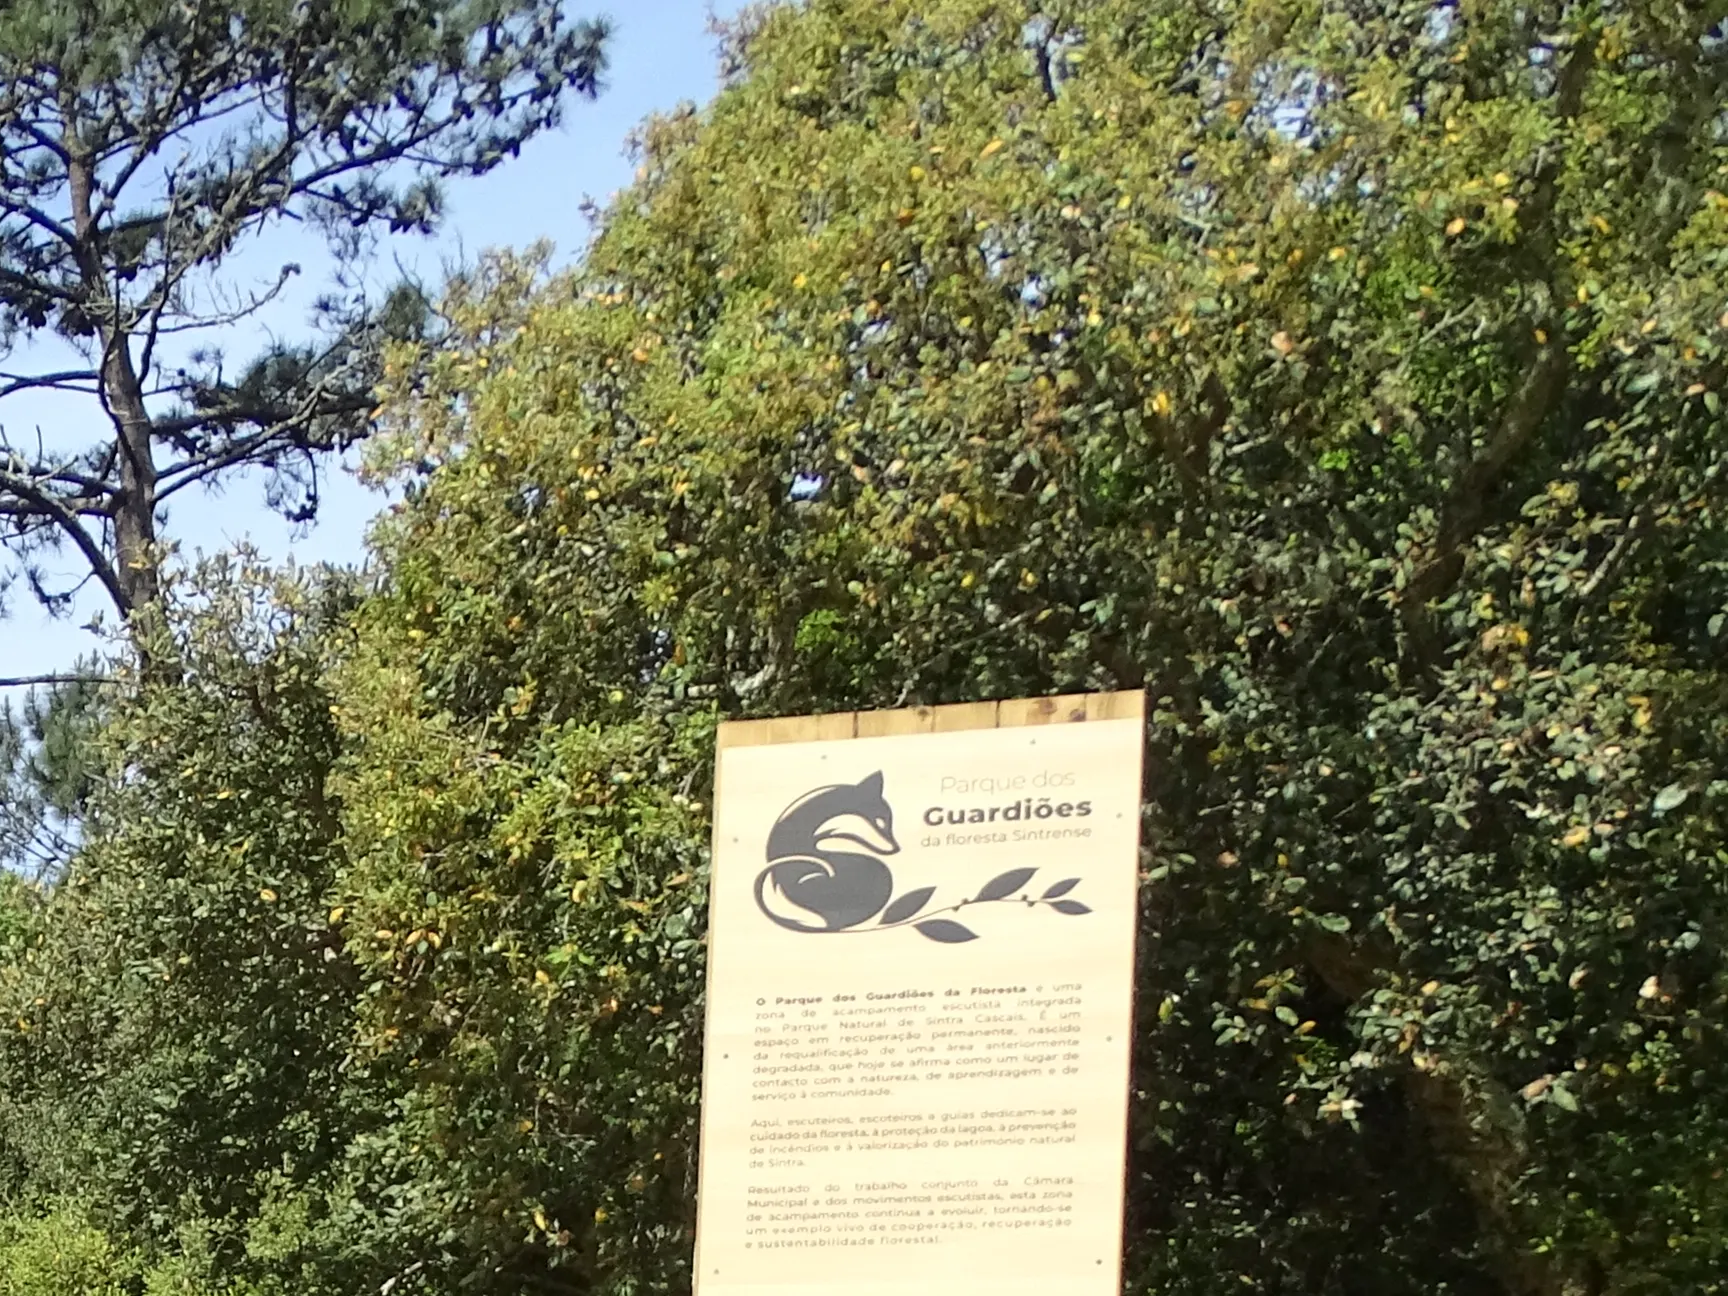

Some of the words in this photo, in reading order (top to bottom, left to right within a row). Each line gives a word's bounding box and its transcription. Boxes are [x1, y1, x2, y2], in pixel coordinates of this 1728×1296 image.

[940, 776, 1027, 795] Parque
[1031, 770, 1076, 788] dos
[923, 797, 1093, 826] Guardiões
[920, 836, 941, 848] da
[945, 831, 1008, 846] floresta
[1012, 826, 1093, 842] Sintrense
[775, 994, 823, 1007] Parque
[832, 992, 856, 1002] dos
[865, 988, 934, 1000] Guardiões
[944, 987, 960, 997] da
[970, 984, 1027, 995] Floresta
[1053, 983, 1082, 991] uma
[756, 1011, 785, 1019] zona
[801, 1007, 816, 1017] de
[833, 1002, 926, 1018] acampamento
[942, 999, 1001, 1011] escutista
[1017, 995, 1082, 1009] integrada
[782, 1021, 827, 1034] Parque
[839, 1018, 887, 1029] Natural
[897, 1017, 914, 1027] de
[926, 1015, 963, 1025] Sintra
[754, 1037, 799, 1048] espaço
[808, 1036, 829, 1044] em
[840, 1030, 921, 1045] recuperação
[1028, 1023, 1081, 1034] nascido
[753, 1050, 768, 1060] da
[880, 1045, 895, 1054] de
[907, 1045, 935, 1053] uma
[986, 1037, 1080, 1050] anteriormente
[828, 1063, 853, 1072] que
[858, 1059, 885, 1071] hoje
[890, 1060, 904, 1068] se
[909, 1056, 950, 1067] afirma
[956, 1057, 991, 1065] como
[1063, 1051, 1079, 1060] de
[752, 1075, 807, 1086] contacto
[814, 1076, 841, 1084] com
[926, 1070, 942, 1080] de
[1062, 1065, 1079, 1074] de
[752, 1090, 796, 1102] serviço
[859, 1111, 923, 1123] escoteiros
[941, 1110, 974, 1122] guias
[981, 1107, 1056, 1118] dedicam-se
[750, 1130, 800, 1140] cuidado
[802, 1129, 817, 1138] da
[882, 1125, 937, 1138] proteção
[940, 1124, 955, 1134] da
[1008, 1120, 1076, 1133] prevenção
[749, 1144, 764, 1154] de
[857, 1139, 928, 1152] valorização
[932, 1138, 949, 1148] do
[1029, 1134, 1076, 1145] natural
[749, 1158, 764, 1168] de
[748, 1183, 810, 1193] Resultado
[824, 1182, 840, 1191] do
[855, 1180, 907, 1190] trabalho
[921, 1178, 978, 1191] conjunto
[993, 1177, 1009, 1186] da
[1024, 1175, 1074, 1185] Câmara
[747, 1196, 808, 1209] Municipal
[825, 1195, 848, 1205] dos
[852, 1193, 932, 1204] movimentos
[1009, 1190, 1036, 1200] esta
[746, 1211, 762, 1221] de
[768, 1209, 859, 1222] acampamento
[993, 1203, 1072, 1214] tornando-se
[836, 1223, 864, 1232] vivo
[868, 1222, 886, 1231] de
[890, 1220, 977, 1233] cooperação,
[981, 1217, 1072, 1231] recuperação
[757, 1236, 875, 1248] sustentabilidade
